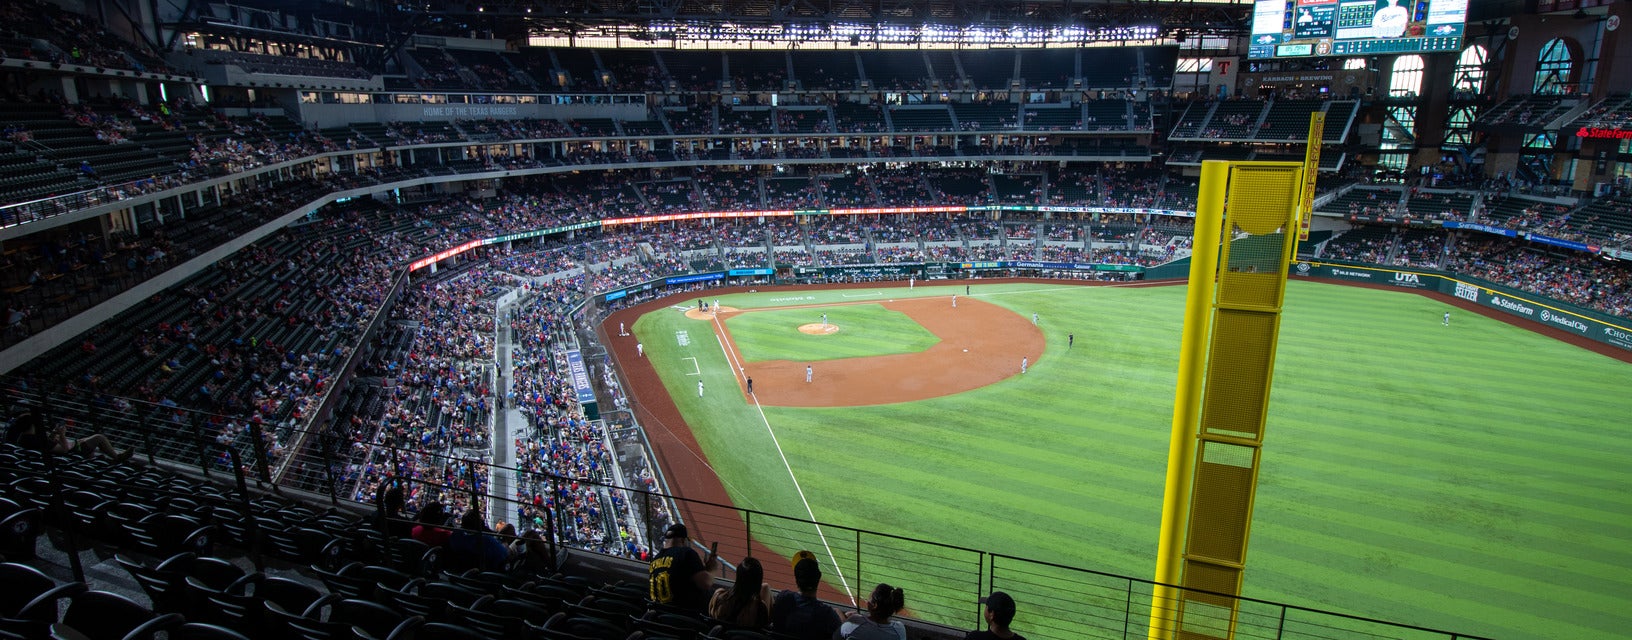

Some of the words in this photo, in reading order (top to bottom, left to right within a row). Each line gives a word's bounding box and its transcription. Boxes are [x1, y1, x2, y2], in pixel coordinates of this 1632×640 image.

[1218, 61, 1231, 75] T
[423, 106, 444, 116] HOME
[445, 106, 454, 116] OF
[455, 106, 468, 116] THE
[469, 106, 489, 116] TEXAS
[489, 106, 517, 115] RANGERS
[1395, 272, 1420, 283] UTA
[1454, 286, 1478, 303] SELTZER
[1550, 314, 1574, 328] Medical
[1574, 321, 1588, 333] City
[650, 572, 672, 604] 10
